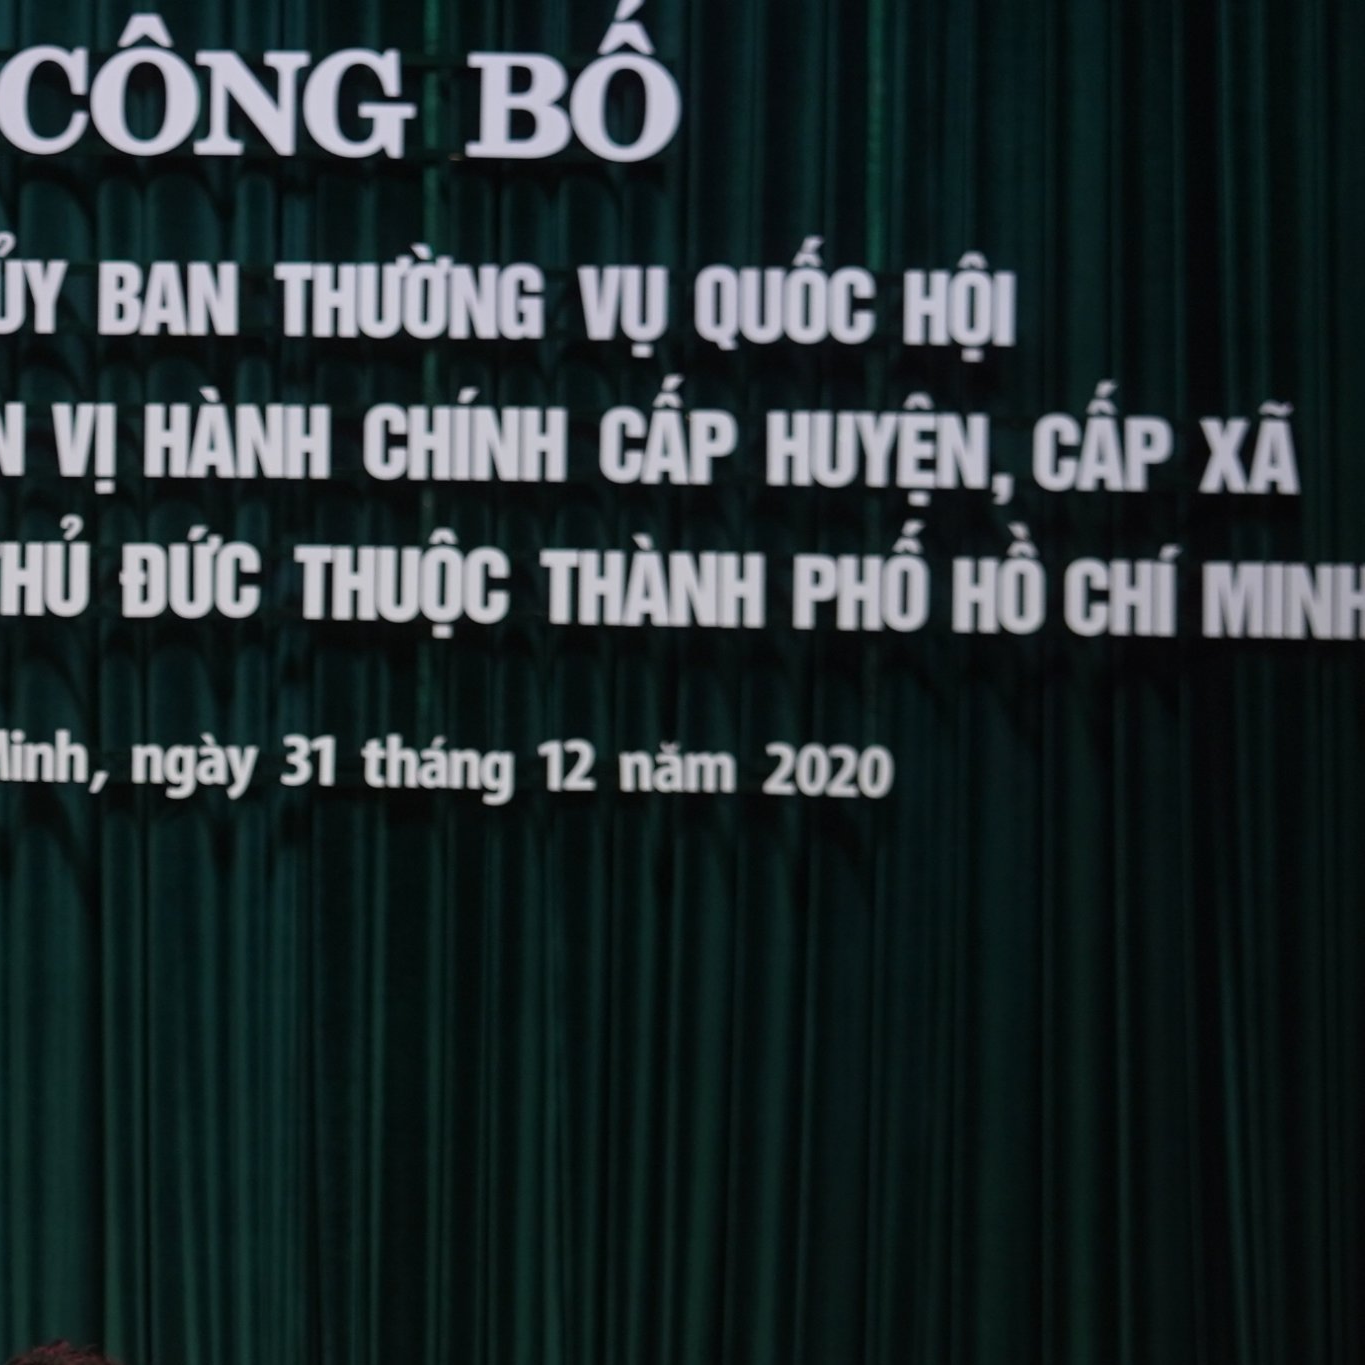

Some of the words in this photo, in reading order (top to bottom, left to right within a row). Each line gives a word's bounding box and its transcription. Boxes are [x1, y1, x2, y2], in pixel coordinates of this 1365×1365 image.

[466, 0, 679, 162] BỐ
[98, 262, 237, 335] BAN
[275, 244, 543, 339] THƯỜNG
[578, 266, 667, 357] VỤ
[695, 237, 874, 350] QUỐC
[904, 253, 1014, 361] HỘI
[52, 403, 115, 494] VỊ
[144, 387, 330, 479] HÀNH
[364, 388, 566, 482] CHÍNH
[600, 375, 736, 484] CẤP
[767, 394, 1012, 505] HUYỆN,
[1034, 382, 1171, 491] CẤP
[1201, 403, 1297, 494] XÃ
[120, 526, 260, 618] ĐỨC
[294, 529, 508, 638] THUỘC
[540, 534, 764, 628] THÀNH
[793, 521, 927, 631] PHỐ
[953, 524, 1044, 633] HỒ
[1065, 546, 1177, 636] CHÍ
[1204, 563, 1365, 639] MINH
[132, 733, 258, 799] ngày
[281, 735, 334, 786] 31
[361, 734, 513, 805] tháng
[538, 740, 595, 791] 12
[620, 744, 735, 792] năm
[763, 743, 892, 797] 2020
